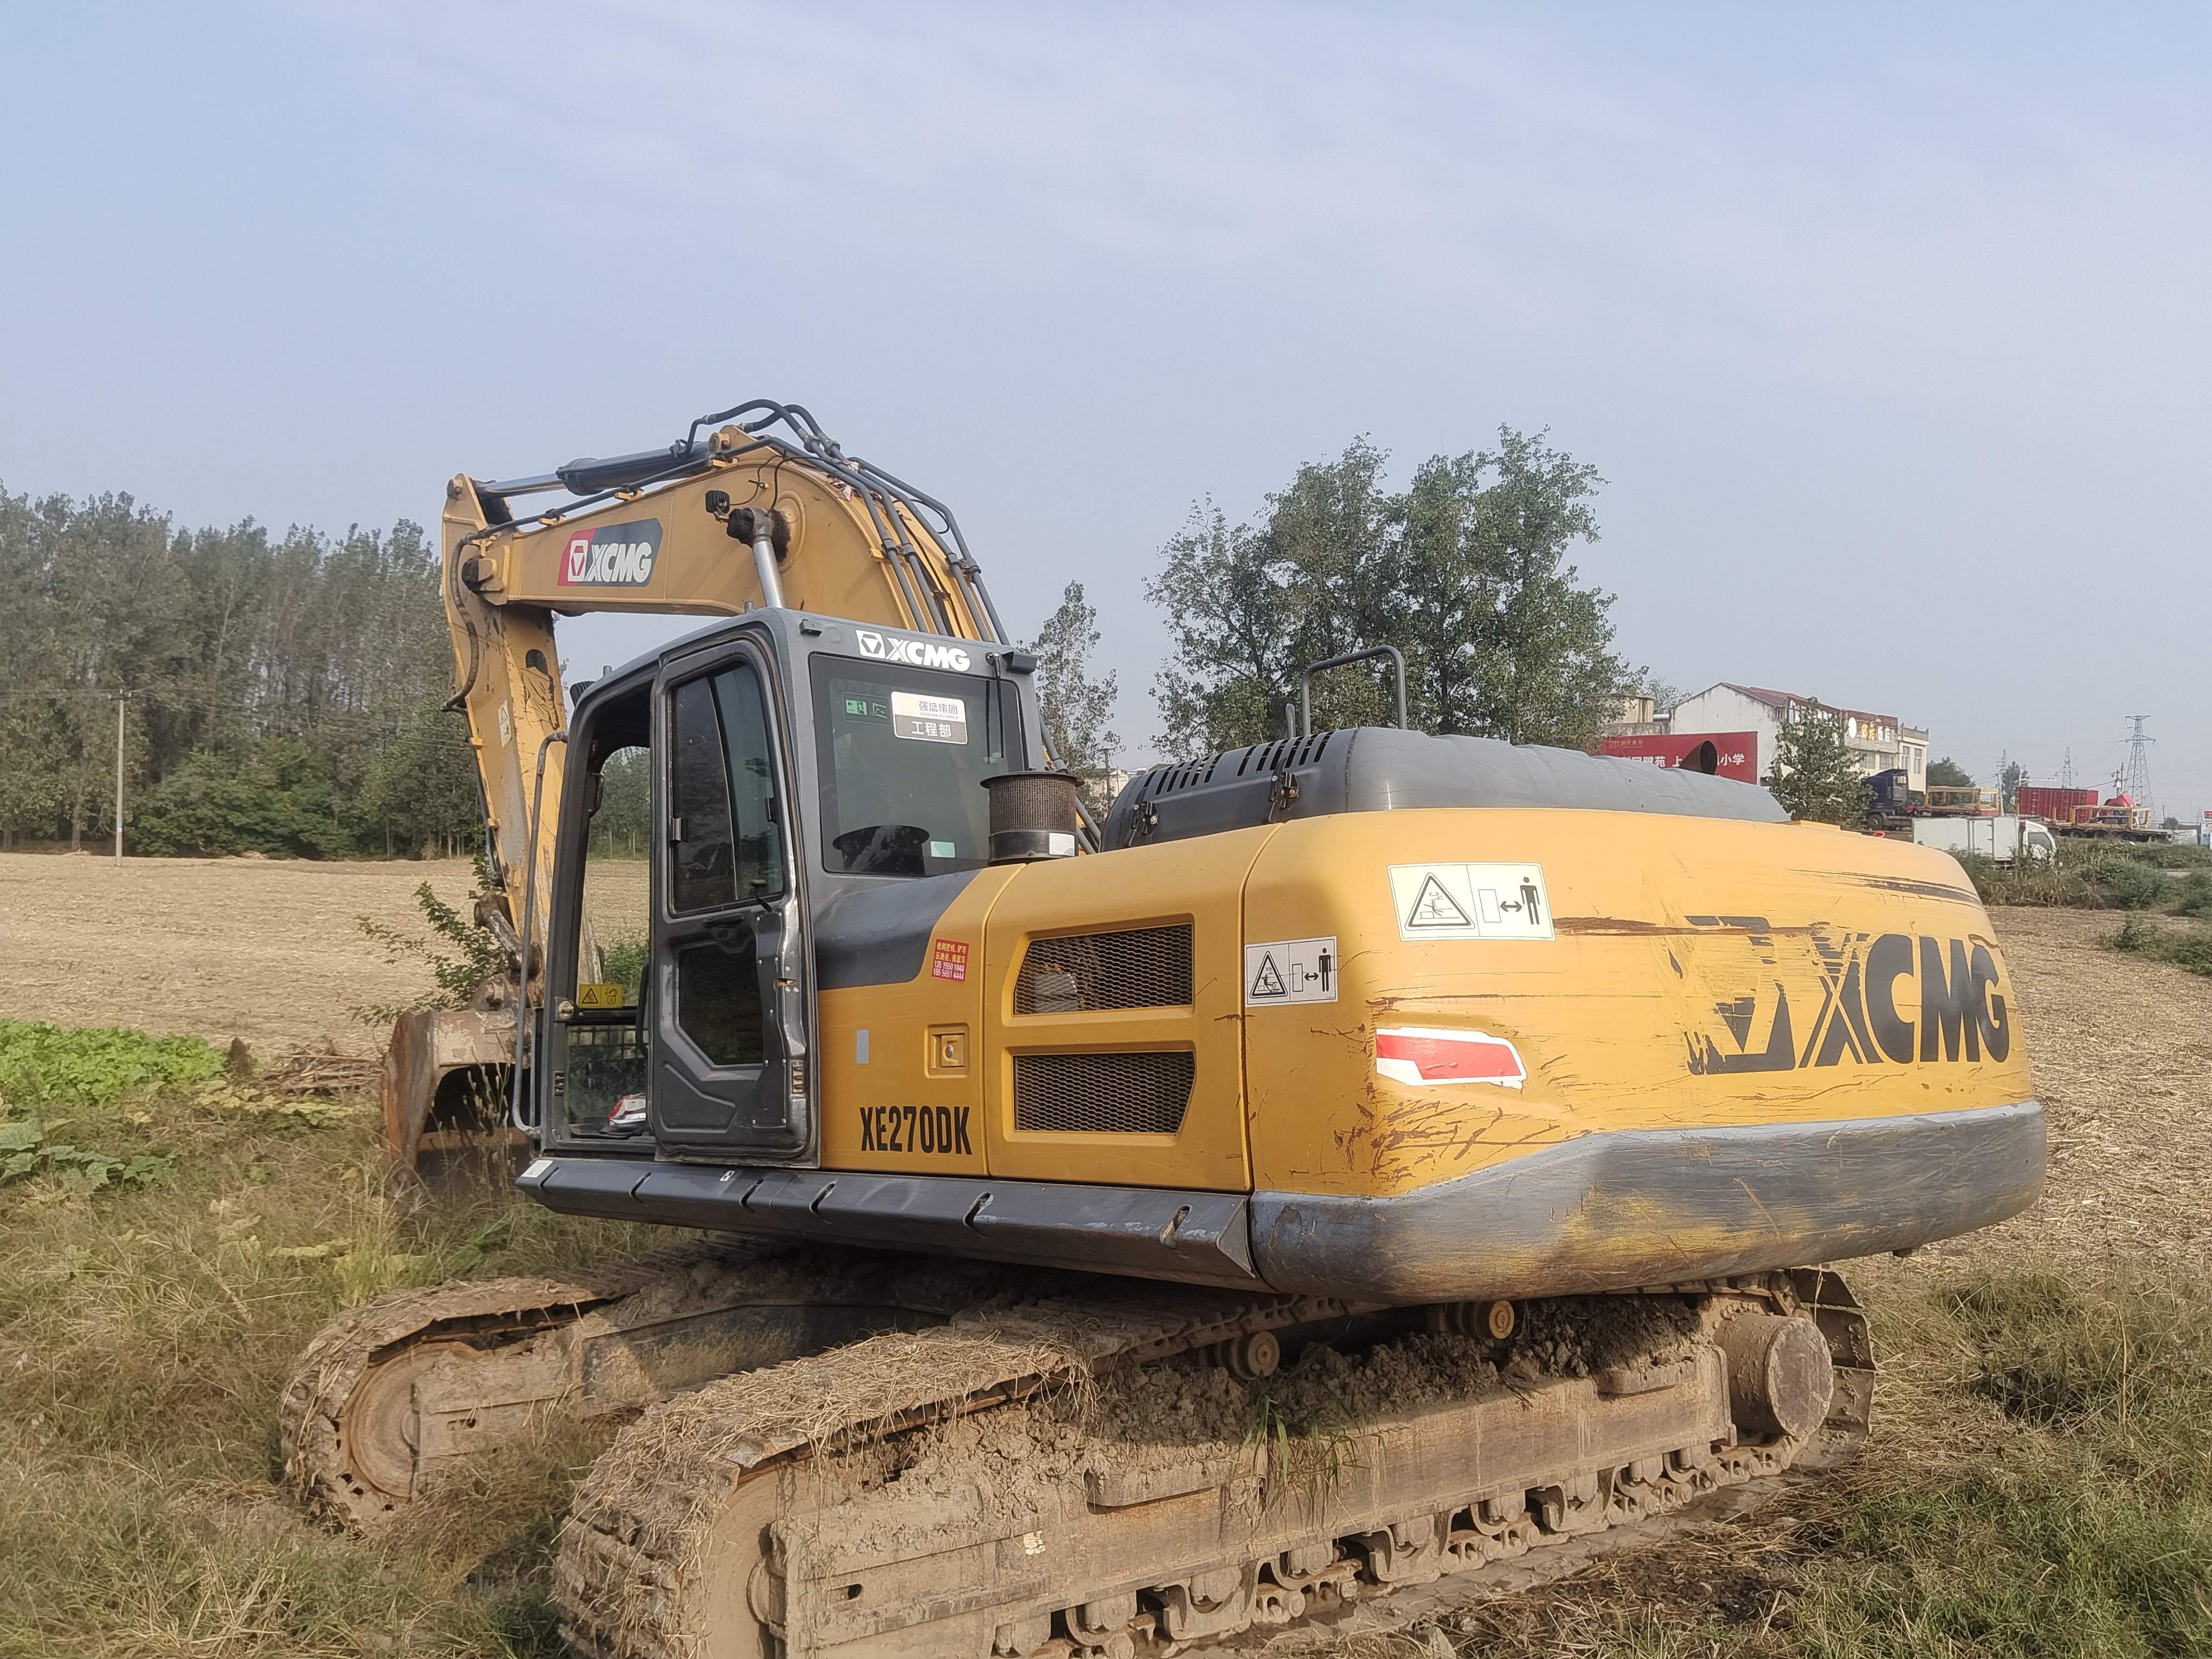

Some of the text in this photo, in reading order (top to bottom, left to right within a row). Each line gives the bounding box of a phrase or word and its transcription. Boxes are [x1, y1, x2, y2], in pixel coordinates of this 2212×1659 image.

[584, 542, 652, 583] XCMG
[885, 637, 970, 672] XCMG
[919, 700, 957, 714] 强盛集团
[911, 721, 951, 738] 工程部
[1798, 933, 2009, 1068] XCMG
[859, 1105, 973, 1155] XE270DK
